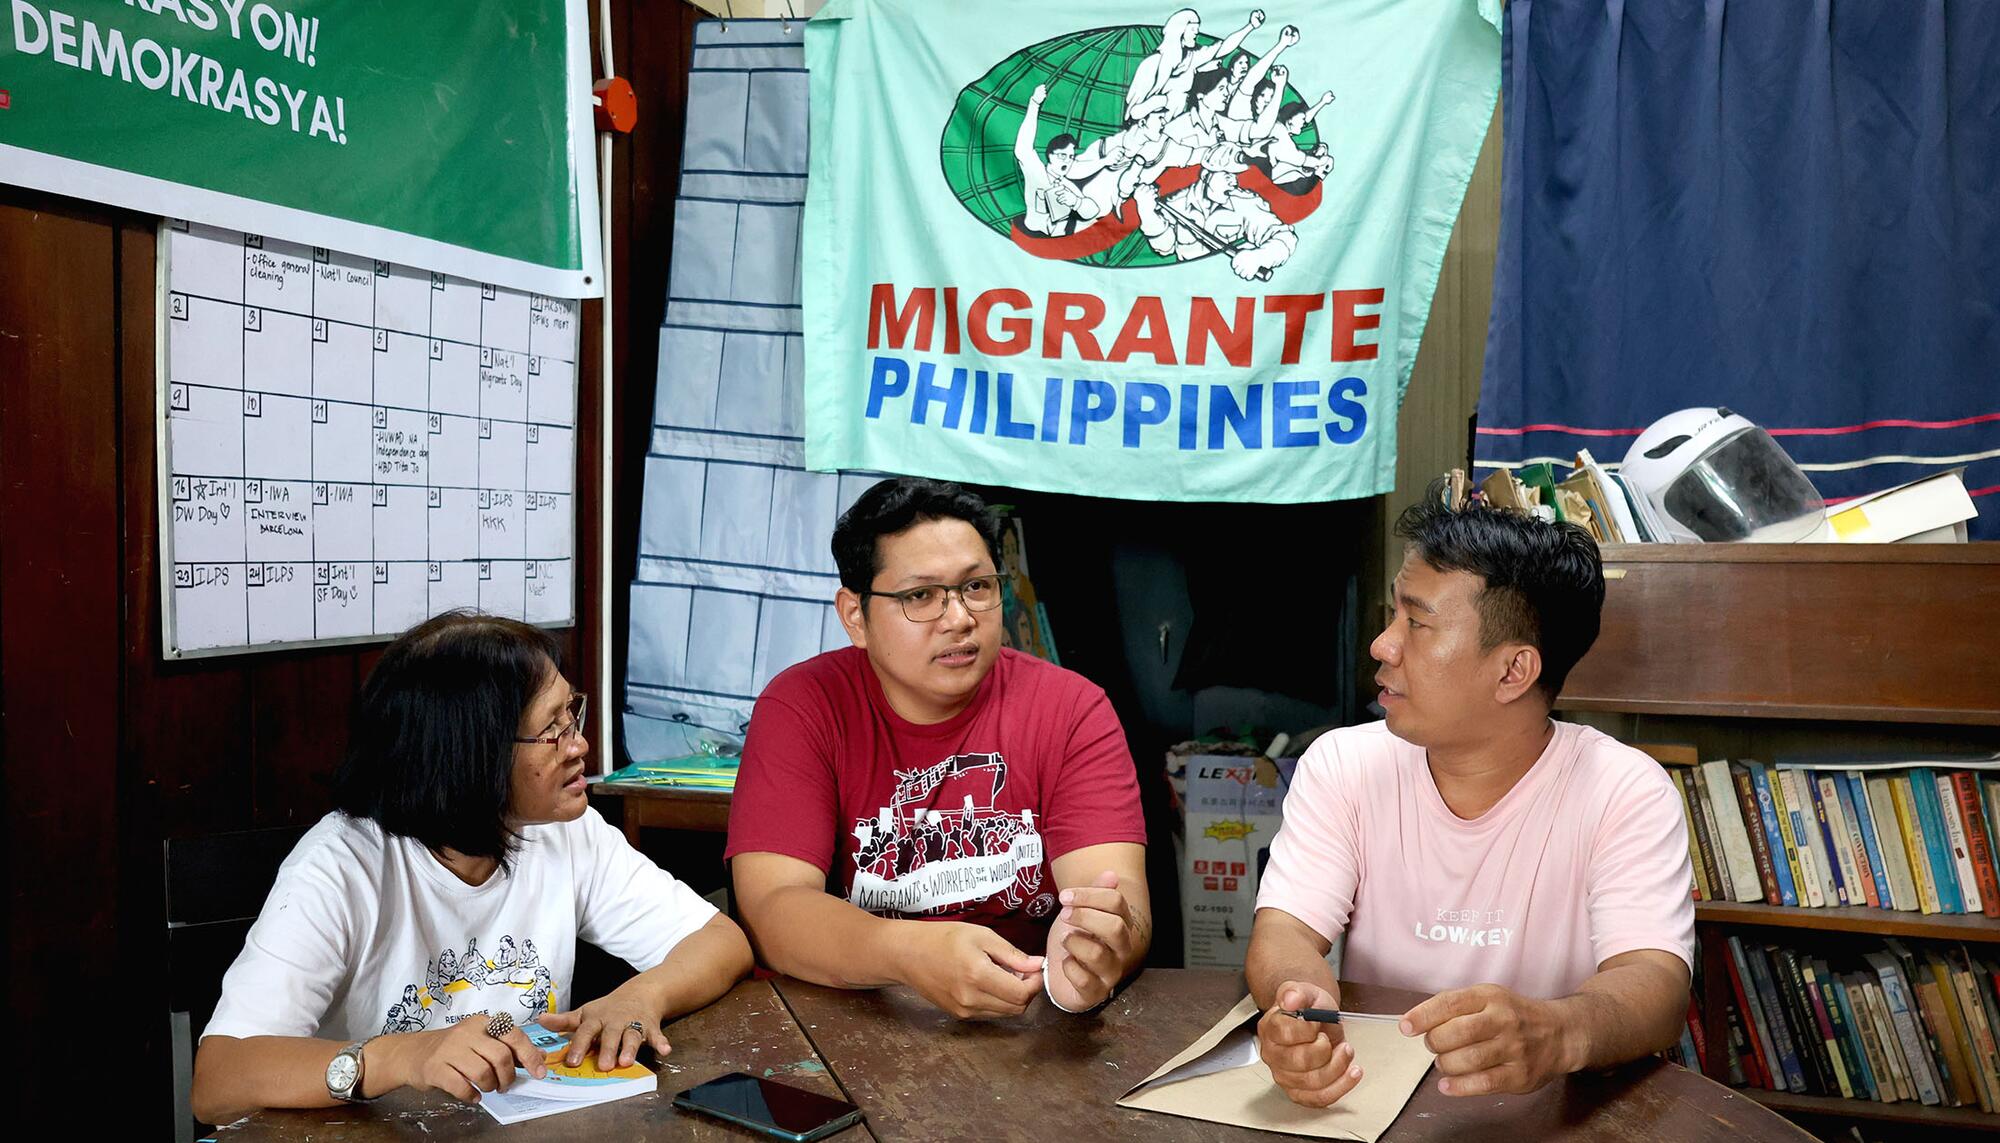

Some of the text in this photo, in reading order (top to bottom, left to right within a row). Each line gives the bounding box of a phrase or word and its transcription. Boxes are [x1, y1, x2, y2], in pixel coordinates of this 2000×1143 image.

[12, 0, 347, 145] DEMOKRASYA!
[346, 271, 373, 286] Council
[173, 298, 183, 313] 2
[248, 310, 256, 325] 3
[866, 283, 1385, 368] MIGRANTE
[314, 321, 323, 338] 4
[376, 332, 383, 344] 5
[433, 342, 439, 353] 6
[173, 389, 182, 404] 9
[246, 395, 257, 411] 10
[865, 356, 1368, 450] PHILIPPINES
[314, 404, 324, 417] 11
[375, 410, 384, 423] 12
[174, 480, 186, 496] 16
[247, 482, 258, 496] 17
[538, 495, 557, 510] ILPS
[175, 505, 218, 526] DW Day
[251, 508, 306, 522] INTERVIEW
[482, 513, 506, 533] KKK
[260, 523, 304, 536] BARCELONA
[195, 566, 230, 587] ILPS
[266, 566, 294, 585] ILPS
[317, 586, 349, 608] SF Day
[859, 880, 922, 910] MIGRANTS
[923, 883, 929, 893] &
[929, 866, 977, 897] WORKERS
[976, 867, 985, 875] OF
[989, 858, 1017, 883] WORLD
[1015, 842, 1040, 861] UNITE!
[1435, 908, 1505, 924] KEEP IT
